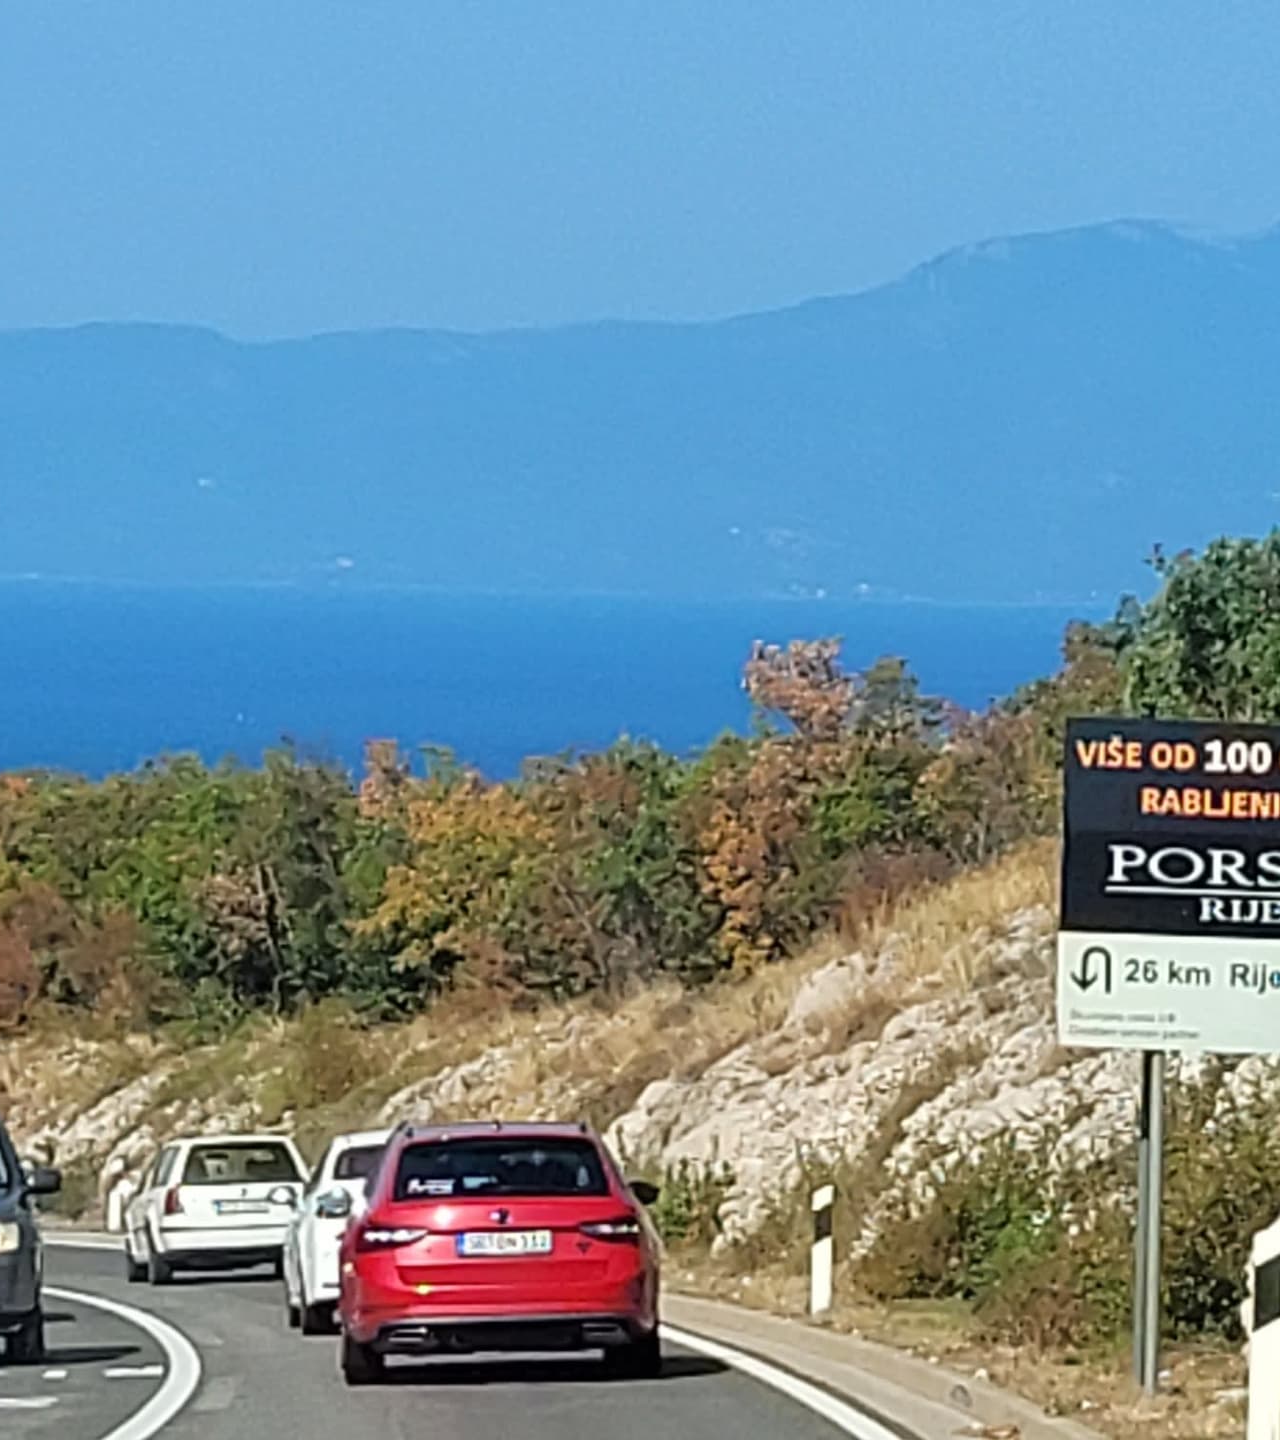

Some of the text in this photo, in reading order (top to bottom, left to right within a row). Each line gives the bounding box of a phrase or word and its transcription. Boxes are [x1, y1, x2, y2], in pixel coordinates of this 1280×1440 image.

[1075, 734, 1142, 769] VIŠE
[1150, 741, 1197, 770] OD
[1203, 739, 1273, 774] 100
[1124, 958, 1158, 984] 26
[1168, 961, 1212, 987] km
